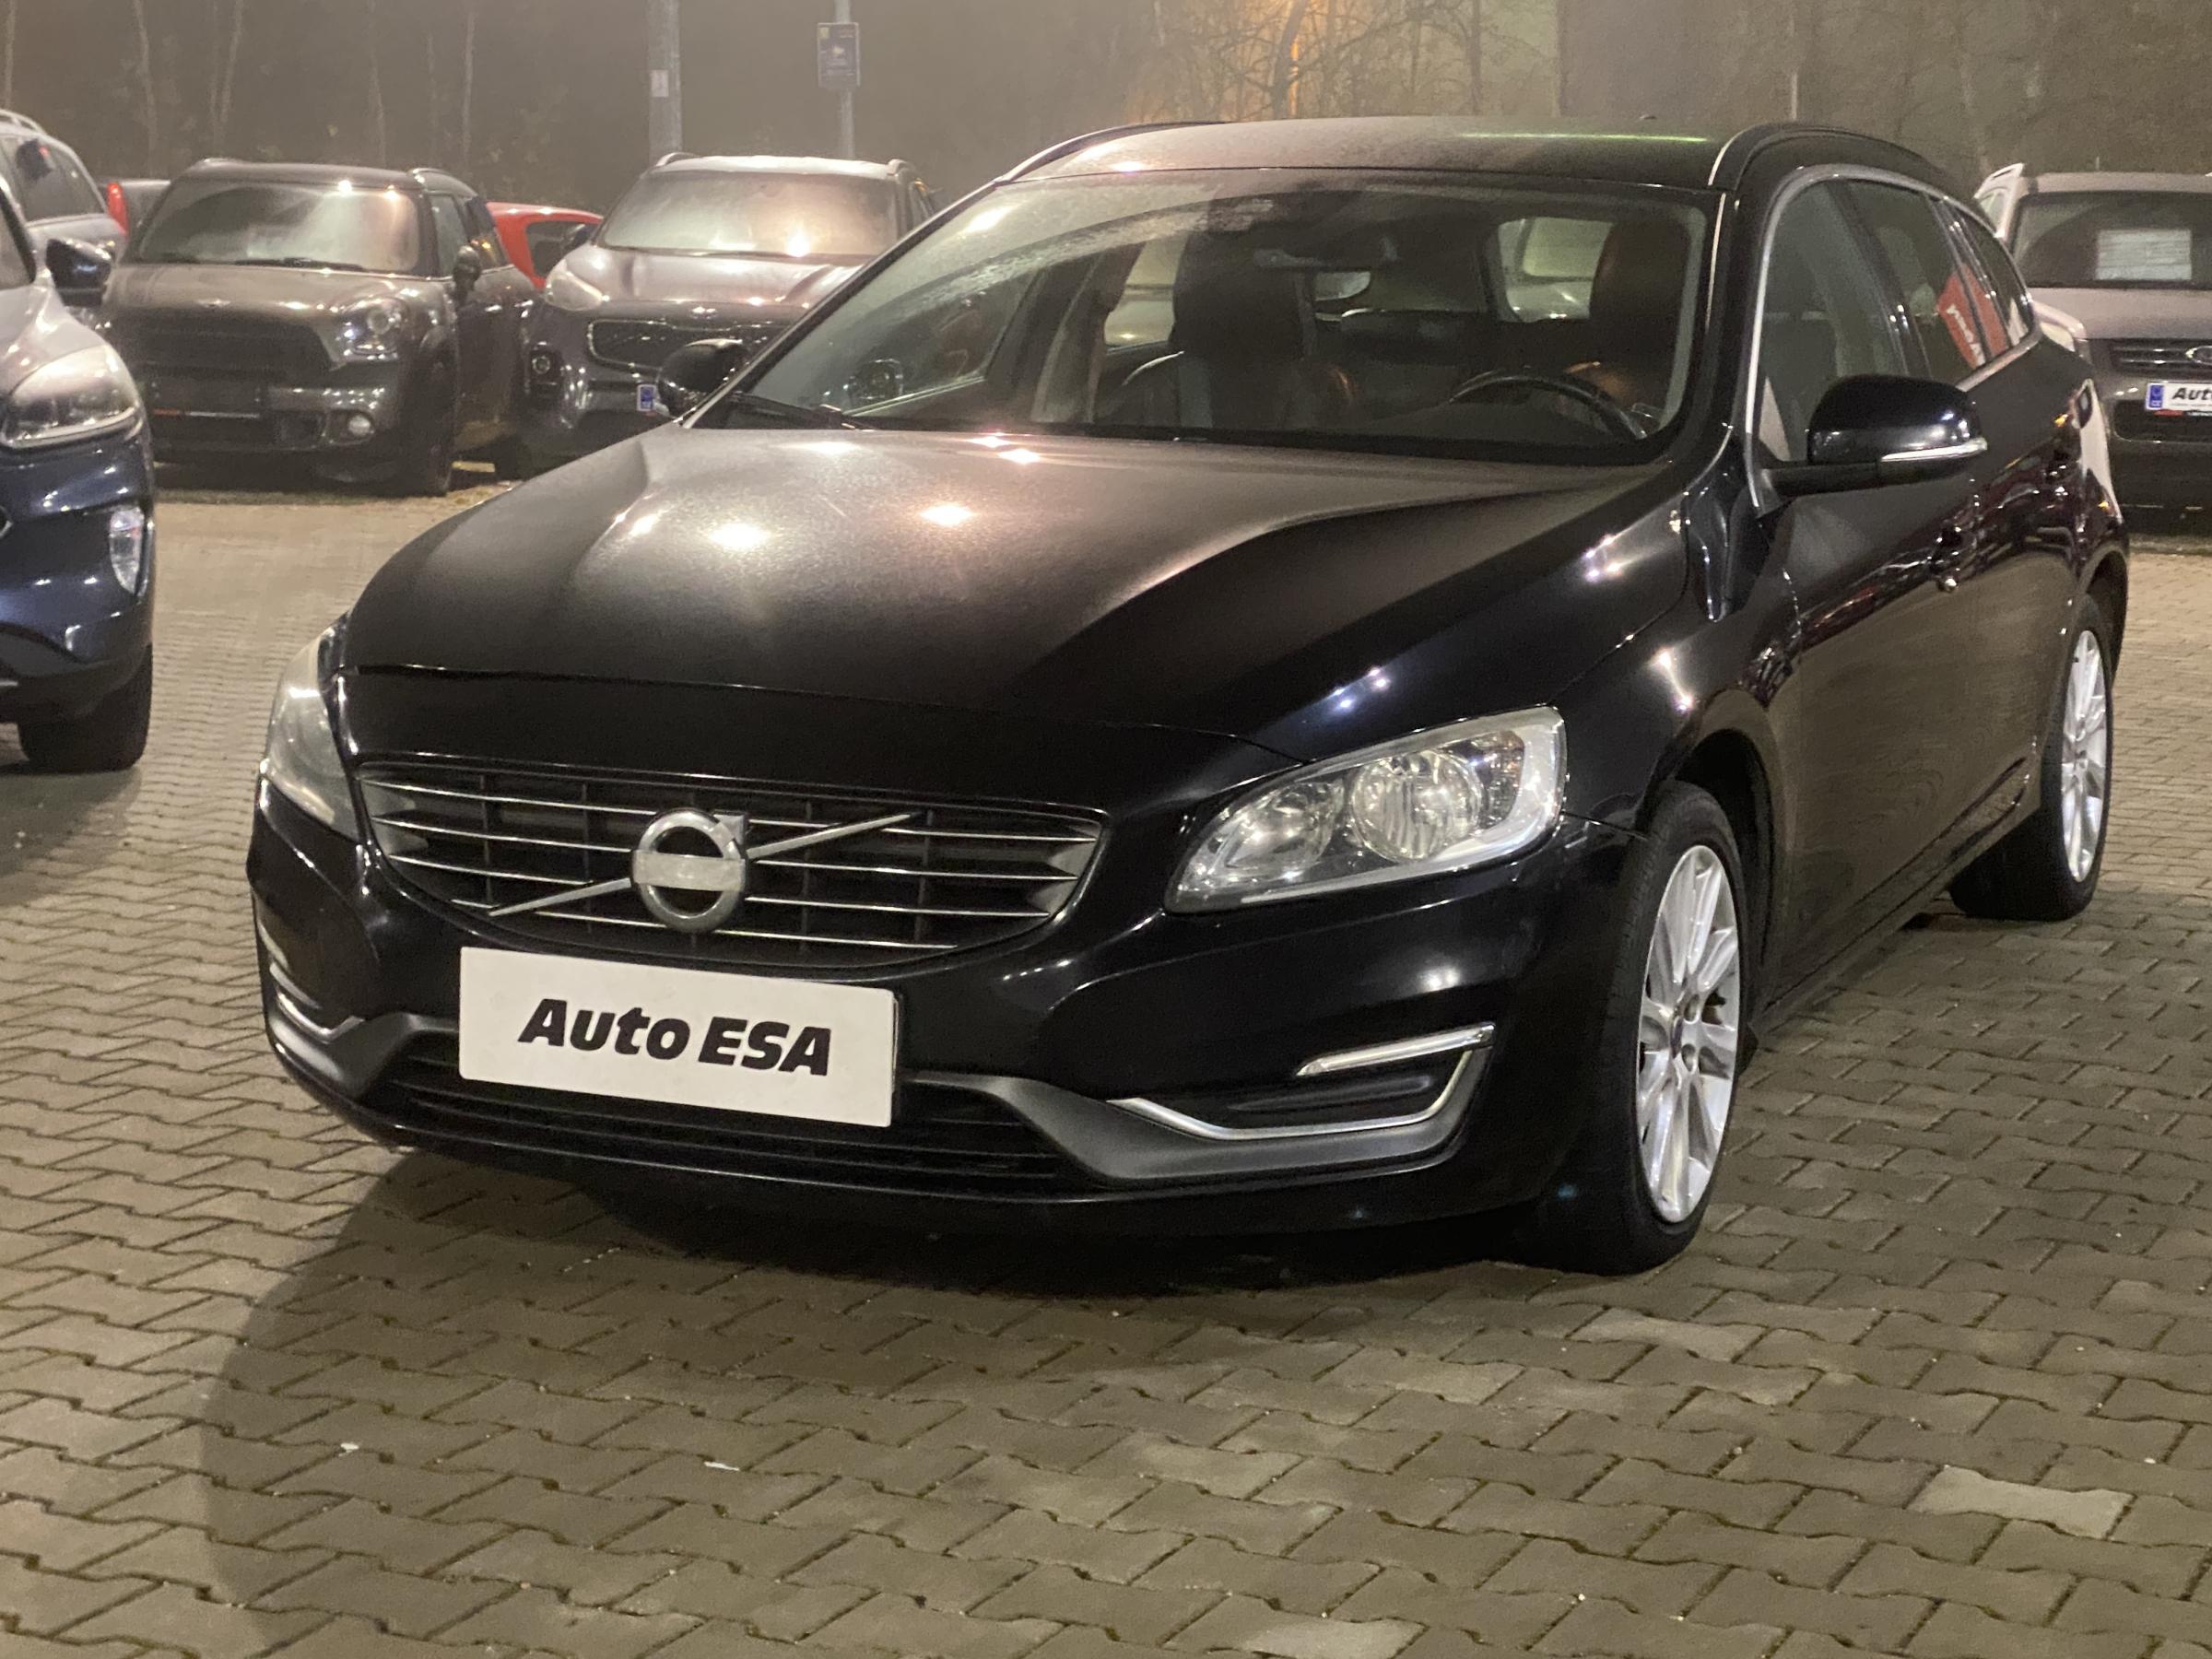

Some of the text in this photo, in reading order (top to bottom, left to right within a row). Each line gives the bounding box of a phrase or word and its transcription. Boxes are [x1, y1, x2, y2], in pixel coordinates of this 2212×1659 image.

[2171, 387, 2212, 401] Aut
[517, 998, 831, 1076] Auto ESA
